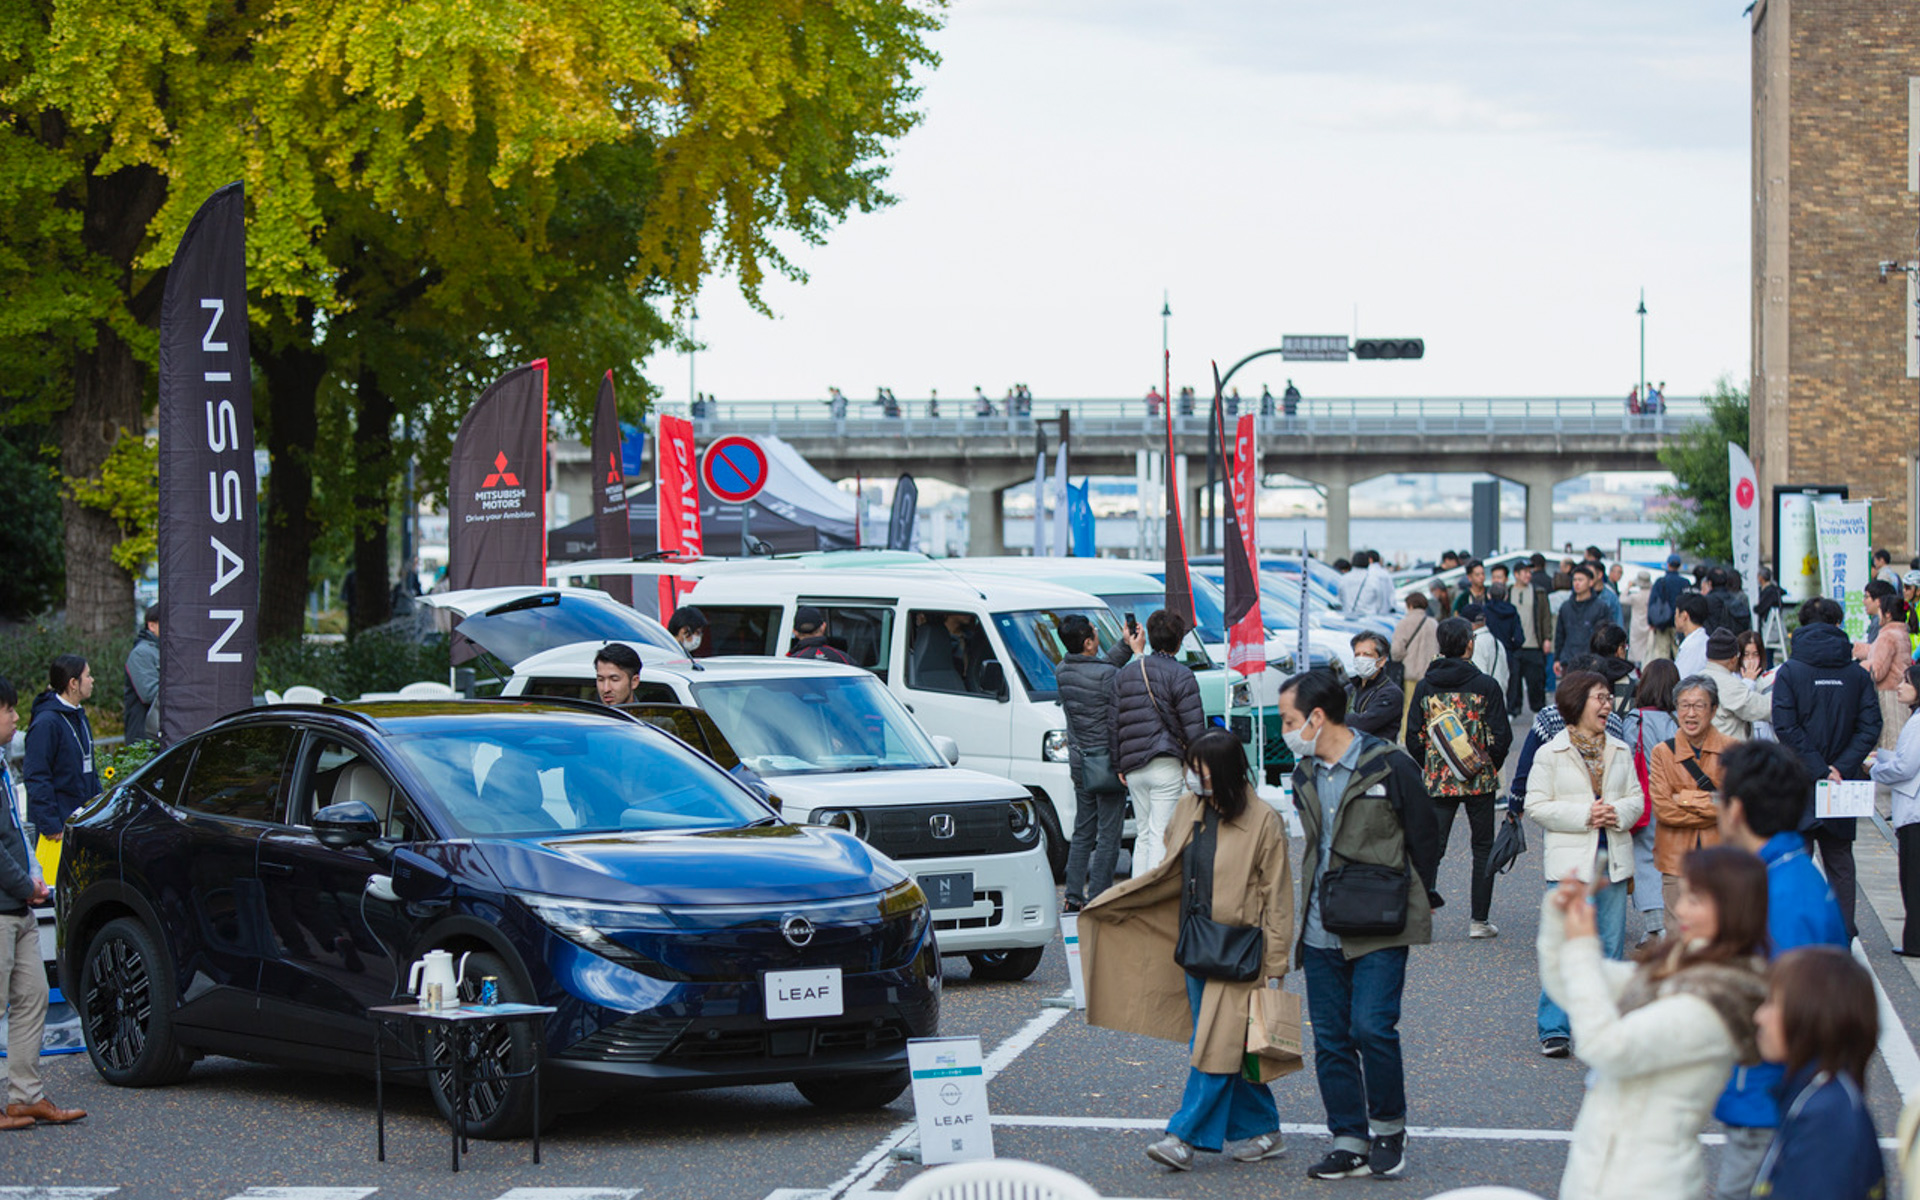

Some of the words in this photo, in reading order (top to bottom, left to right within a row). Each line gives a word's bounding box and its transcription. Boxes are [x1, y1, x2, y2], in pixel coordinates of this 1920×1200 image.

[200, 298, 244, 663] NISSAN
[475, 489, 526, 501] MITSUBISHI
[482, 499, 521, 509] MOTORS
[465, 514, 485, 523] Drive
[486, 512, 502, 522] your
[503, 511, 536, 519] Ambition
[783, 926, 816, 935] NISSAN
[779, 986, 829, 1001] LEAF
[935, 1114, 974, 1127] LEAF
